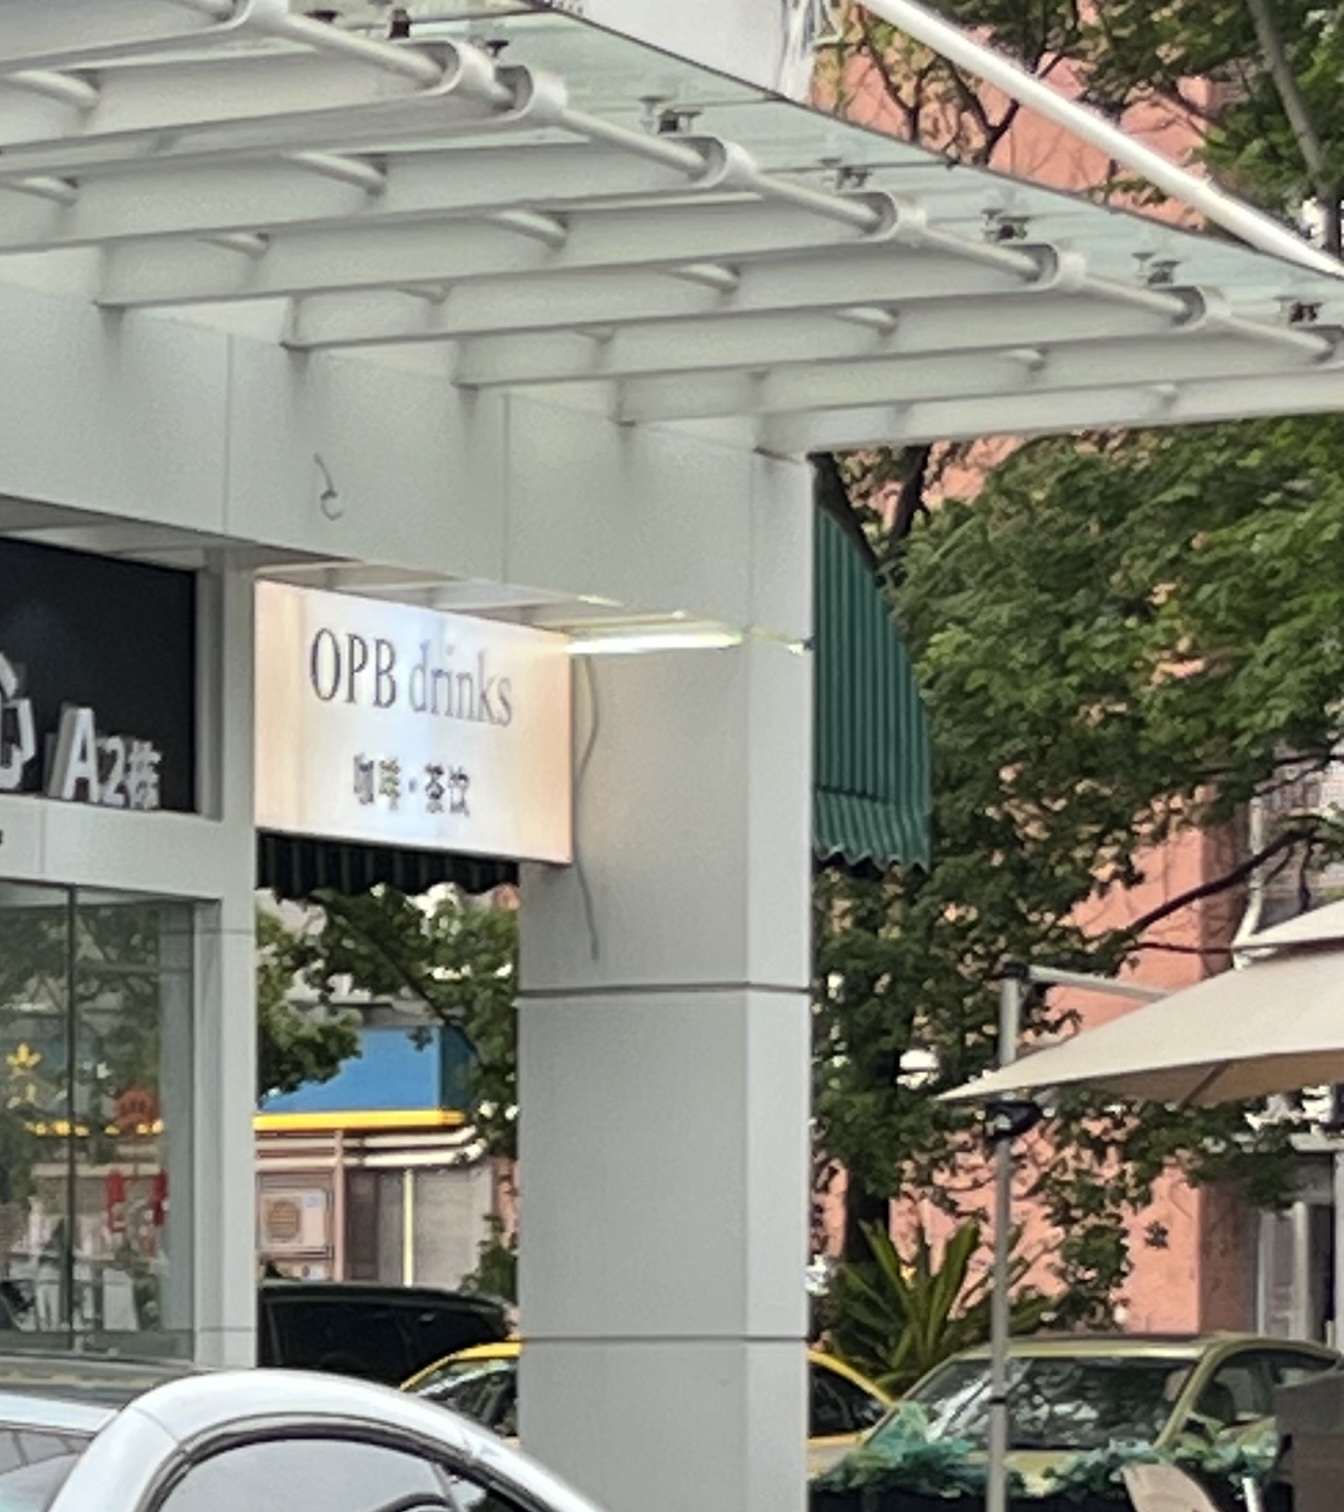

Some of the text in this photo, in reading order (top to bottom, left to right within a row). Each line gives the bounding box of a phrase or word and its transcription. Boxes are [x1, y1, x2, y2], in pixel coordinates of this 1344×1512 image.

[310, 627, 514, 728] OPB drinks
[60, 706, 162, 810] A2栋
